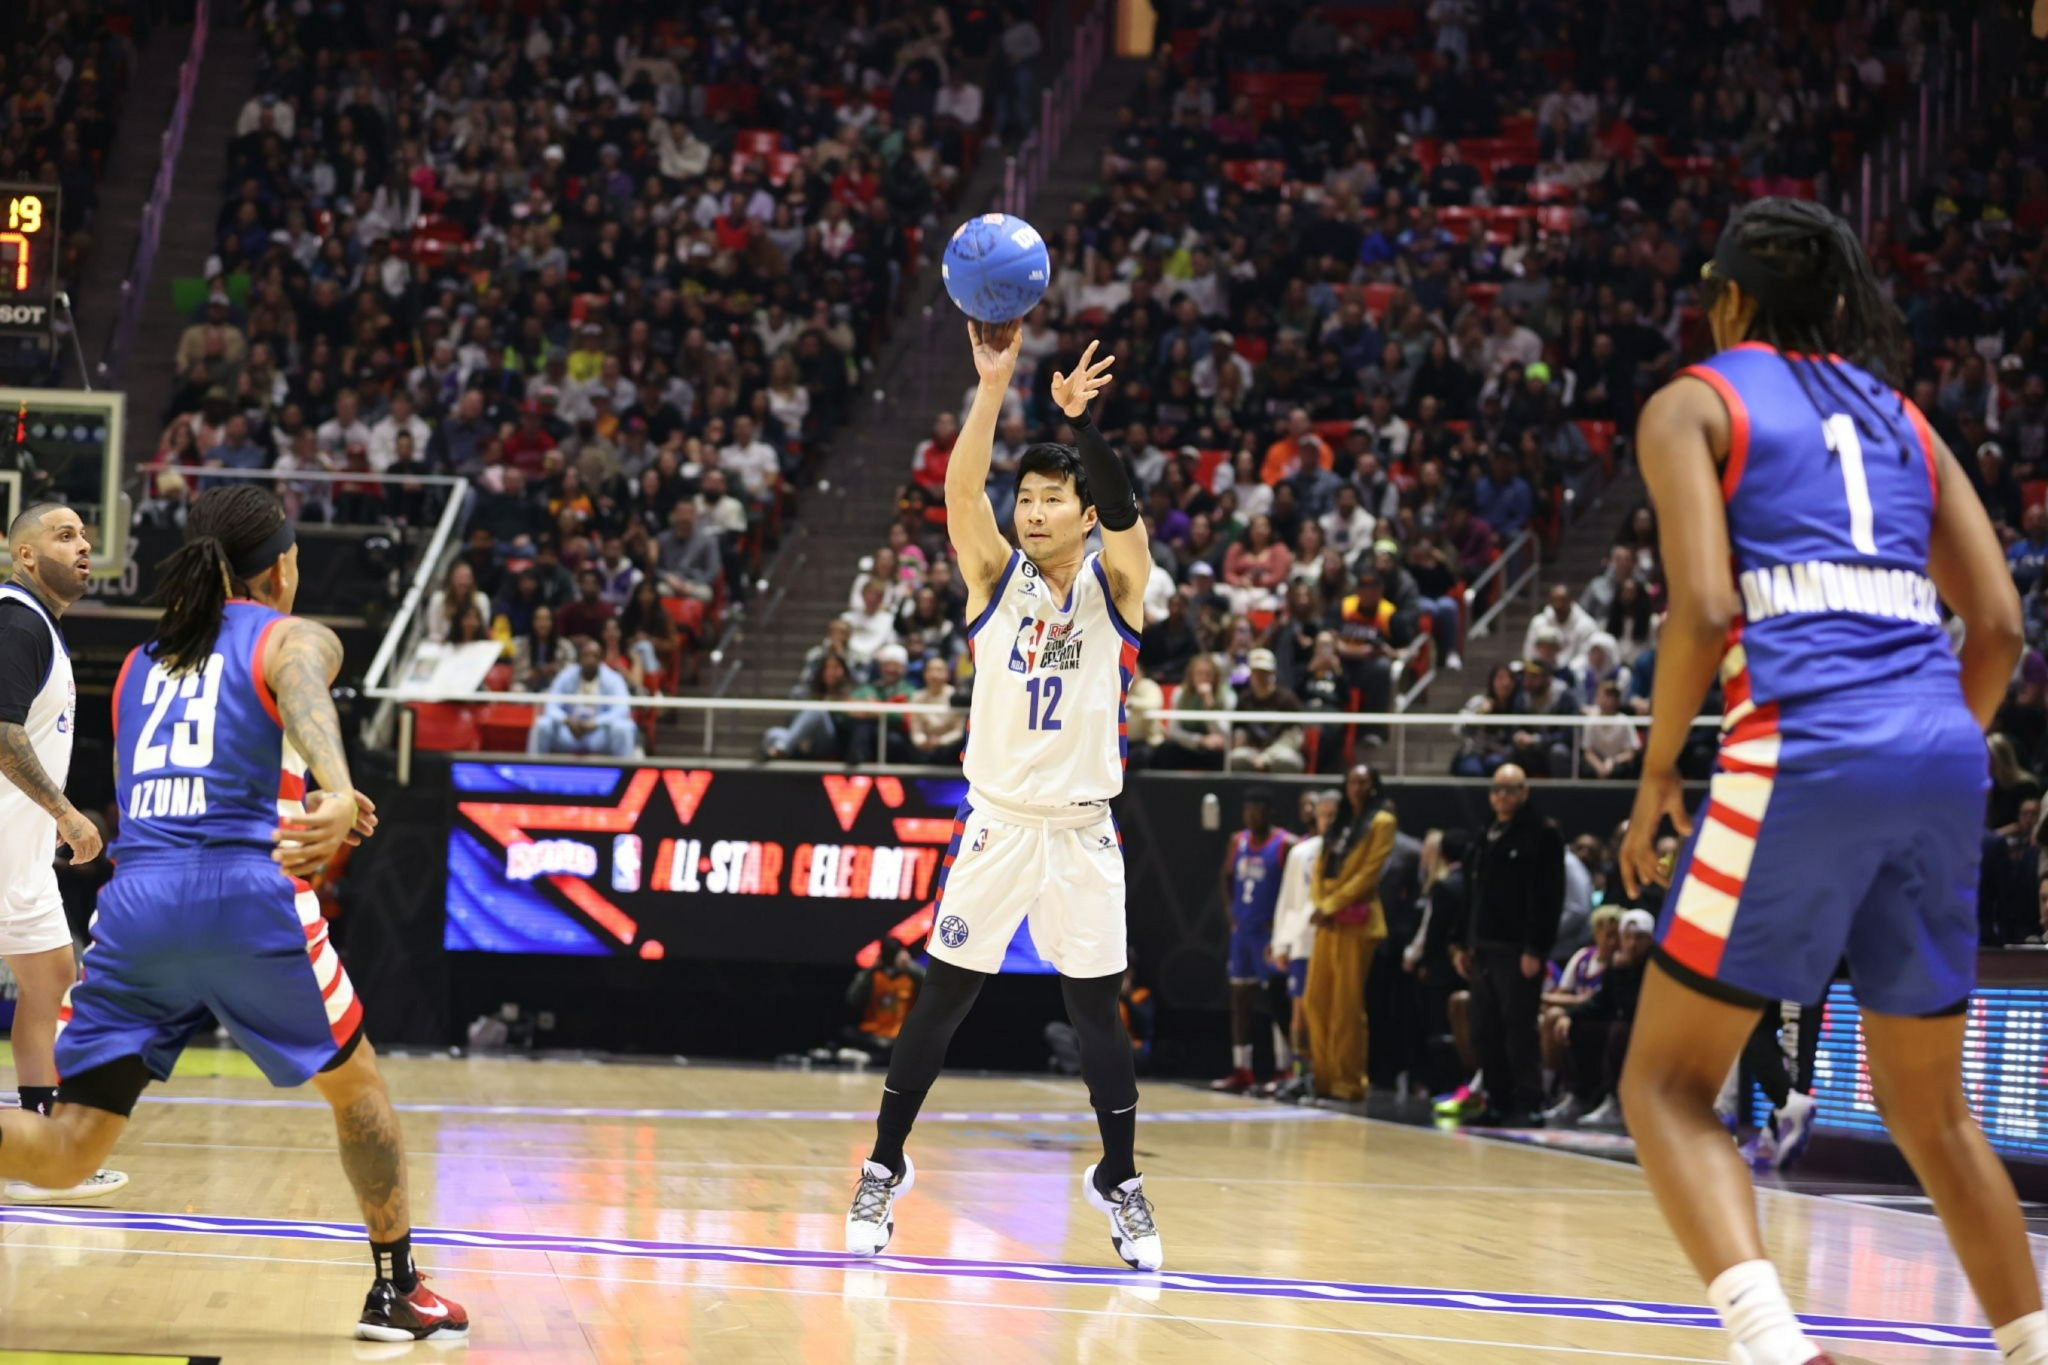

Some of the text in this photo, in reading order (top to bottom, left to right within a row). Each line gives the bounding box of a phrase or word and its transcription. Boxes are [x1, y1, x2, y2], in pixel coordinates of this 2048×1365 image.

[1822, 414, 1878, 555] 1
[1060, 660, 1079, 670] GAME
[133, 653, 224, 775] 23
[1026, 676, 1063, 731] 12
[129, 777, 206, 820] OZUNA
[790, 843, 938, 900] CELEBRITY
